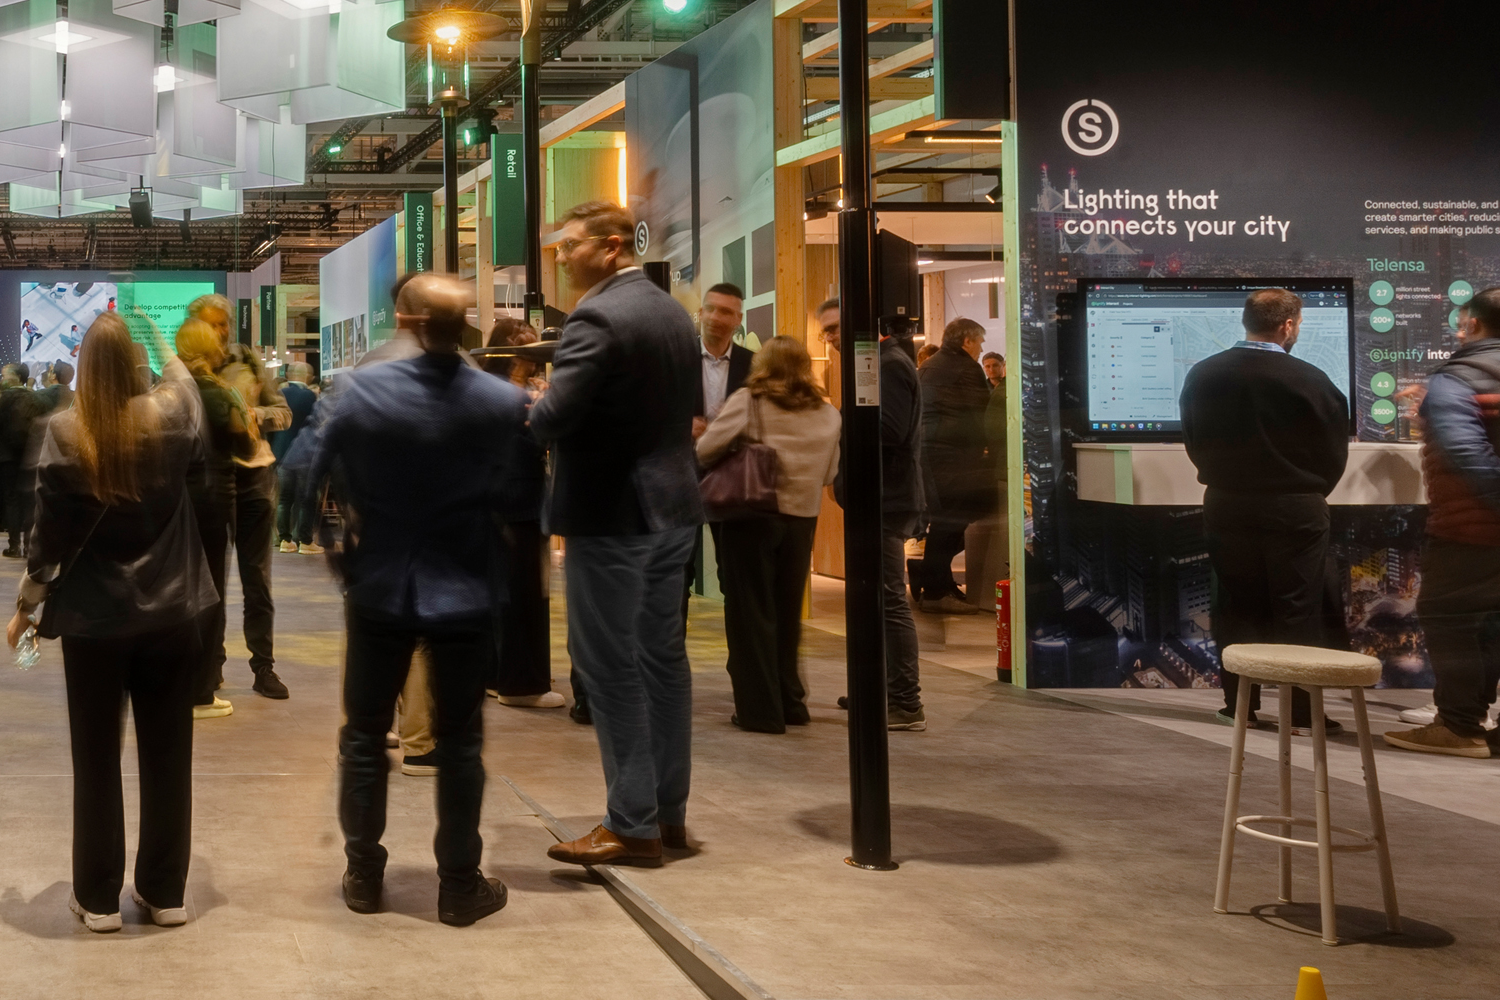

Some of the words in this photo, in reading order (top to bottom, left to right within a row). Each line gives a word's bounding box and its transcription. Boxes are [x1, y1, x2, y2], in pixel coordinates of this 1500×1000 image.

[506, 149, 517, 179] Retail
[1064, 188, 1158, 216] Lighting
[1166, 189, 1219, 210] that
[1364, 200, 1420, 210] Connected,
[1422, 200, 1479, 210] sustainable,
[1480, 200, 1499, 210] and
[416, 205, 425, 232] Office
[1364, 213, 1397, 222] create
[1398, 213, 1437, 222] smarter
[1438, 212, 1467, 223] cities,
[1064, 215, 1177, 236] connects
[1185, 220, 1236, 242] your
[1244, 215, 1291, 242] city
[1365, 225, 1408, 235] services,
[1409, 225, 1428, 235] and
[1429, 225, 1463, 237] making
[1465, 225, 1494, 237] public
[416, 233, 425, 241] &
[416, 243, 425, 274] Educat
[1366, 258, 1426, 272] Telensa
[1376, 289, 1388, 297] 2.7
[1451, 289, 1470, 297] 450+
[1372, 316, 1392, 324] 200+
[1373, 407, 1394, 415] 3500+
